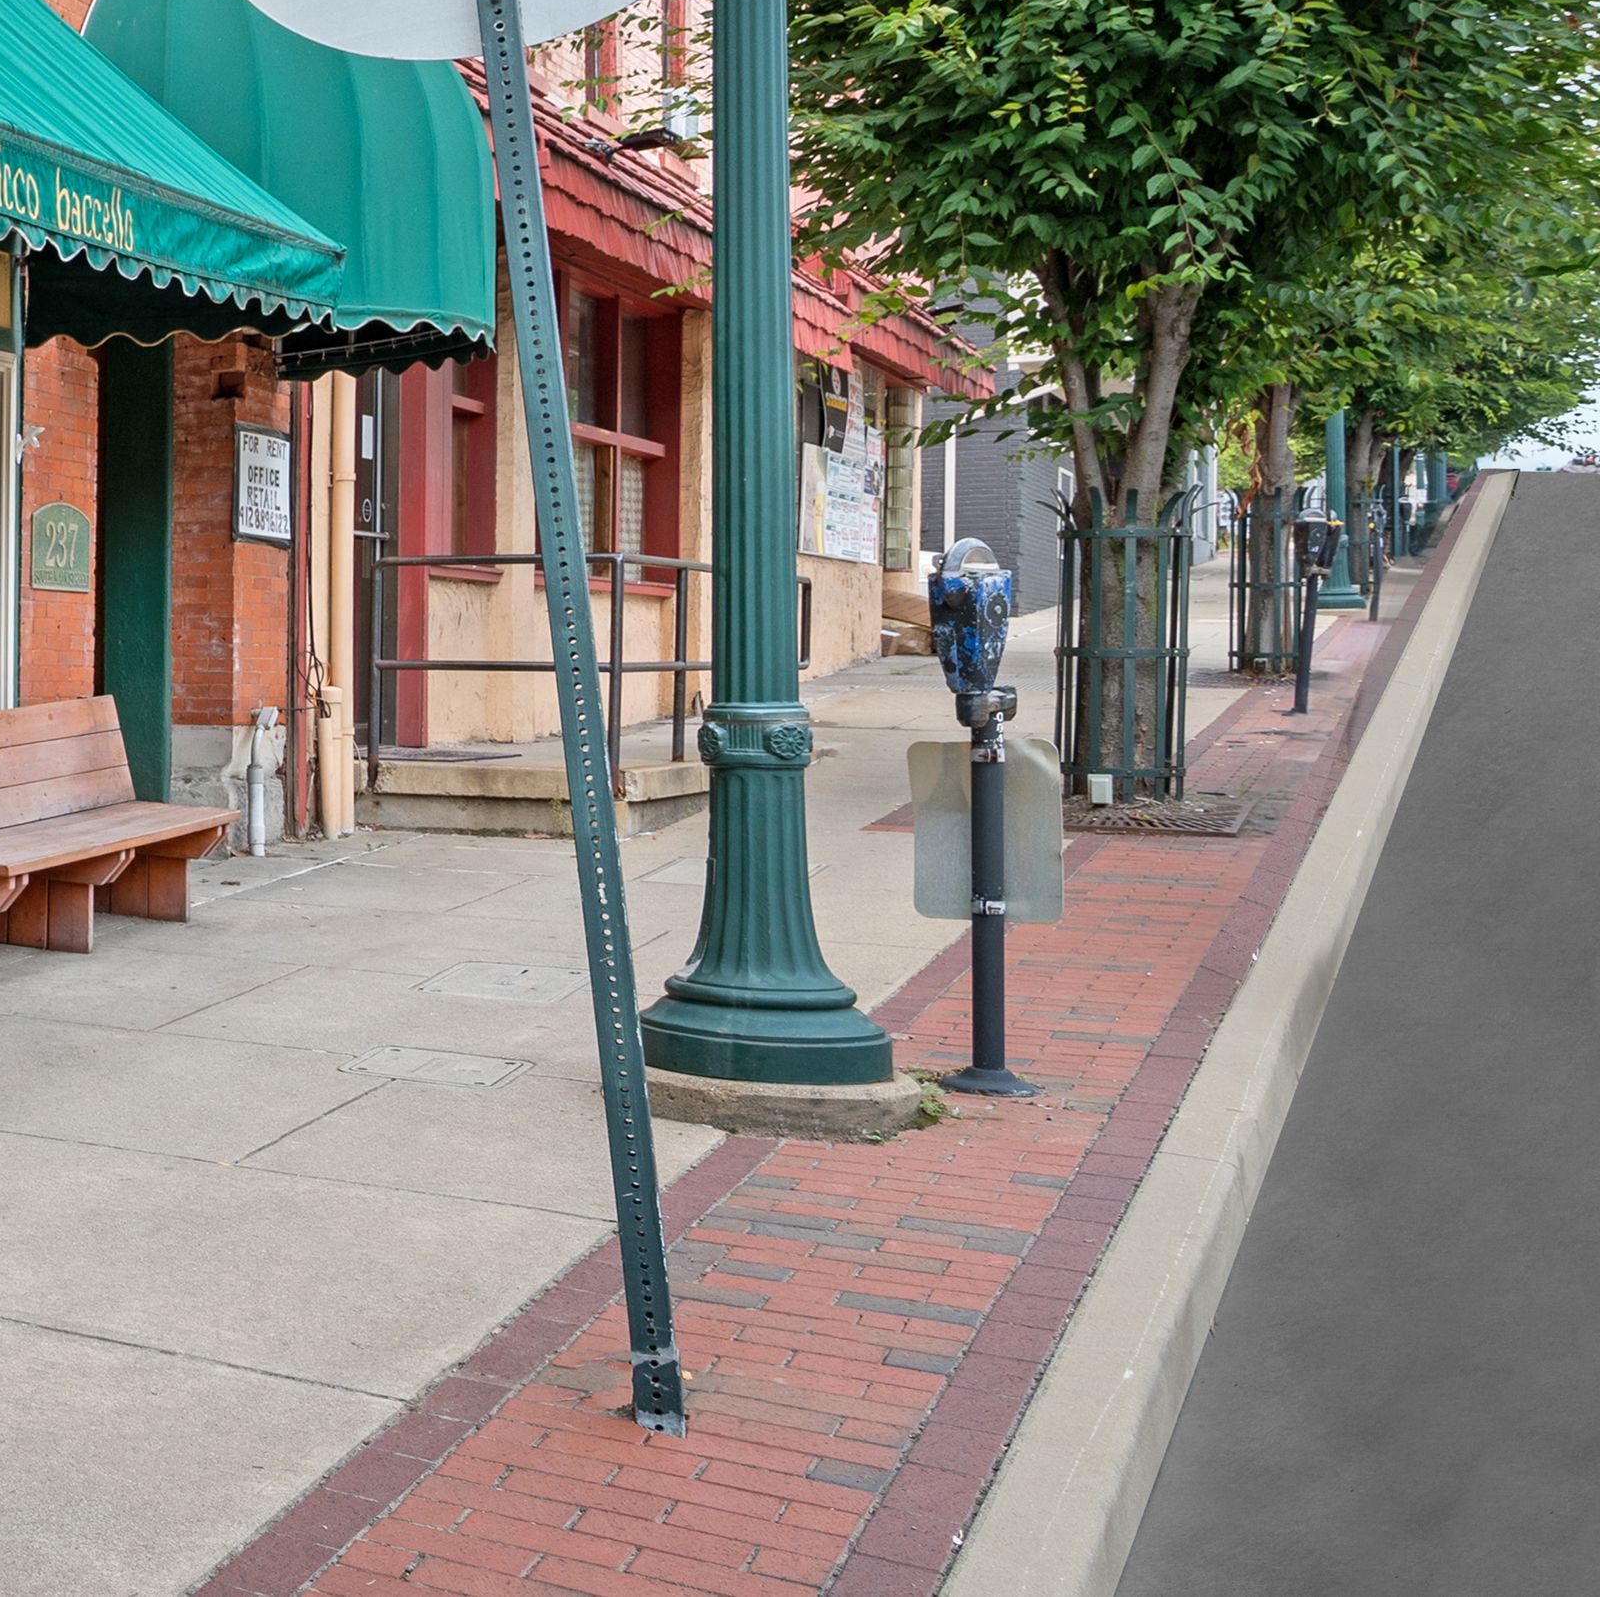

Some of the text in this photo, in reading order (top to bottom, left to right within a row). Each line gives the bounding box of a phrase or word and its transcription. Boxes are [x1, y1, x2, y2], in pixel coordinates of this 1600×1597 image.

[56, 166, 135, 252] baccello
[242, 433, 288, 460] FOR RENT
[247, 465, 281, 488] OFFICE
[247, 486, 281, 512] RETAIL
[45, 520, 79, 569] 237
